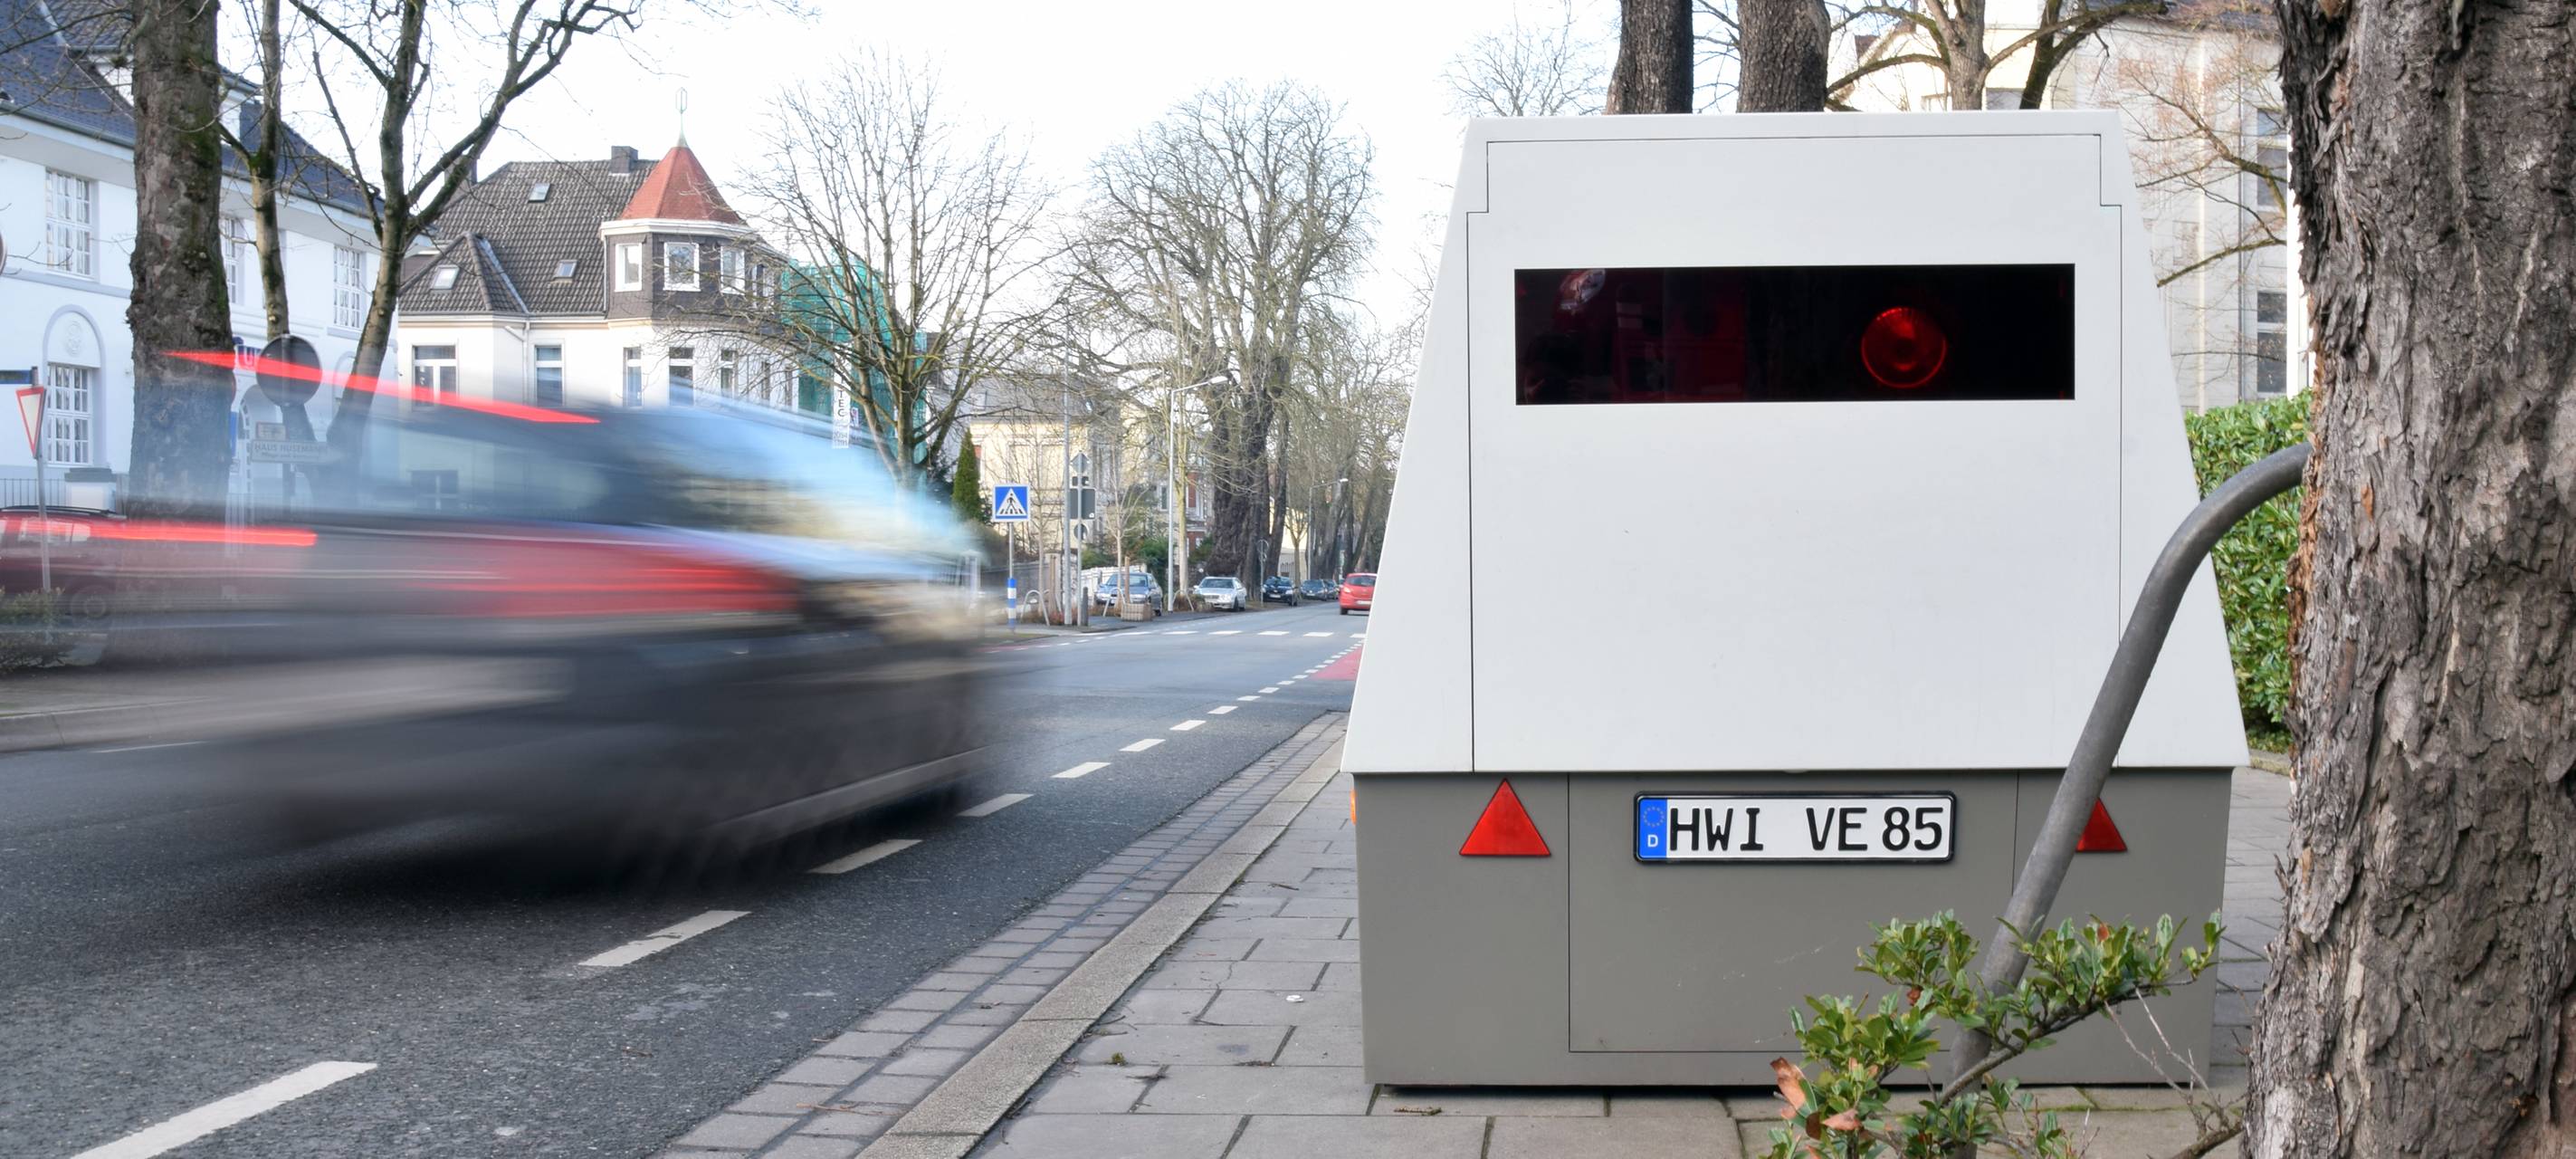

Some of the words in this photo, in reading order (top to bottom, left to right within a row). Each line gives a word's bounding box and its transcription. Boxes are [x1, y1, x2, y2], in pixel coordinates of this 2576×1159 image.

[1647, 834, 1658, 848] D
[1669, 807, 1764, 851] HWI
[1806, 807, 1868, 851] VE
[1881, 806, 1944, 851] 85
